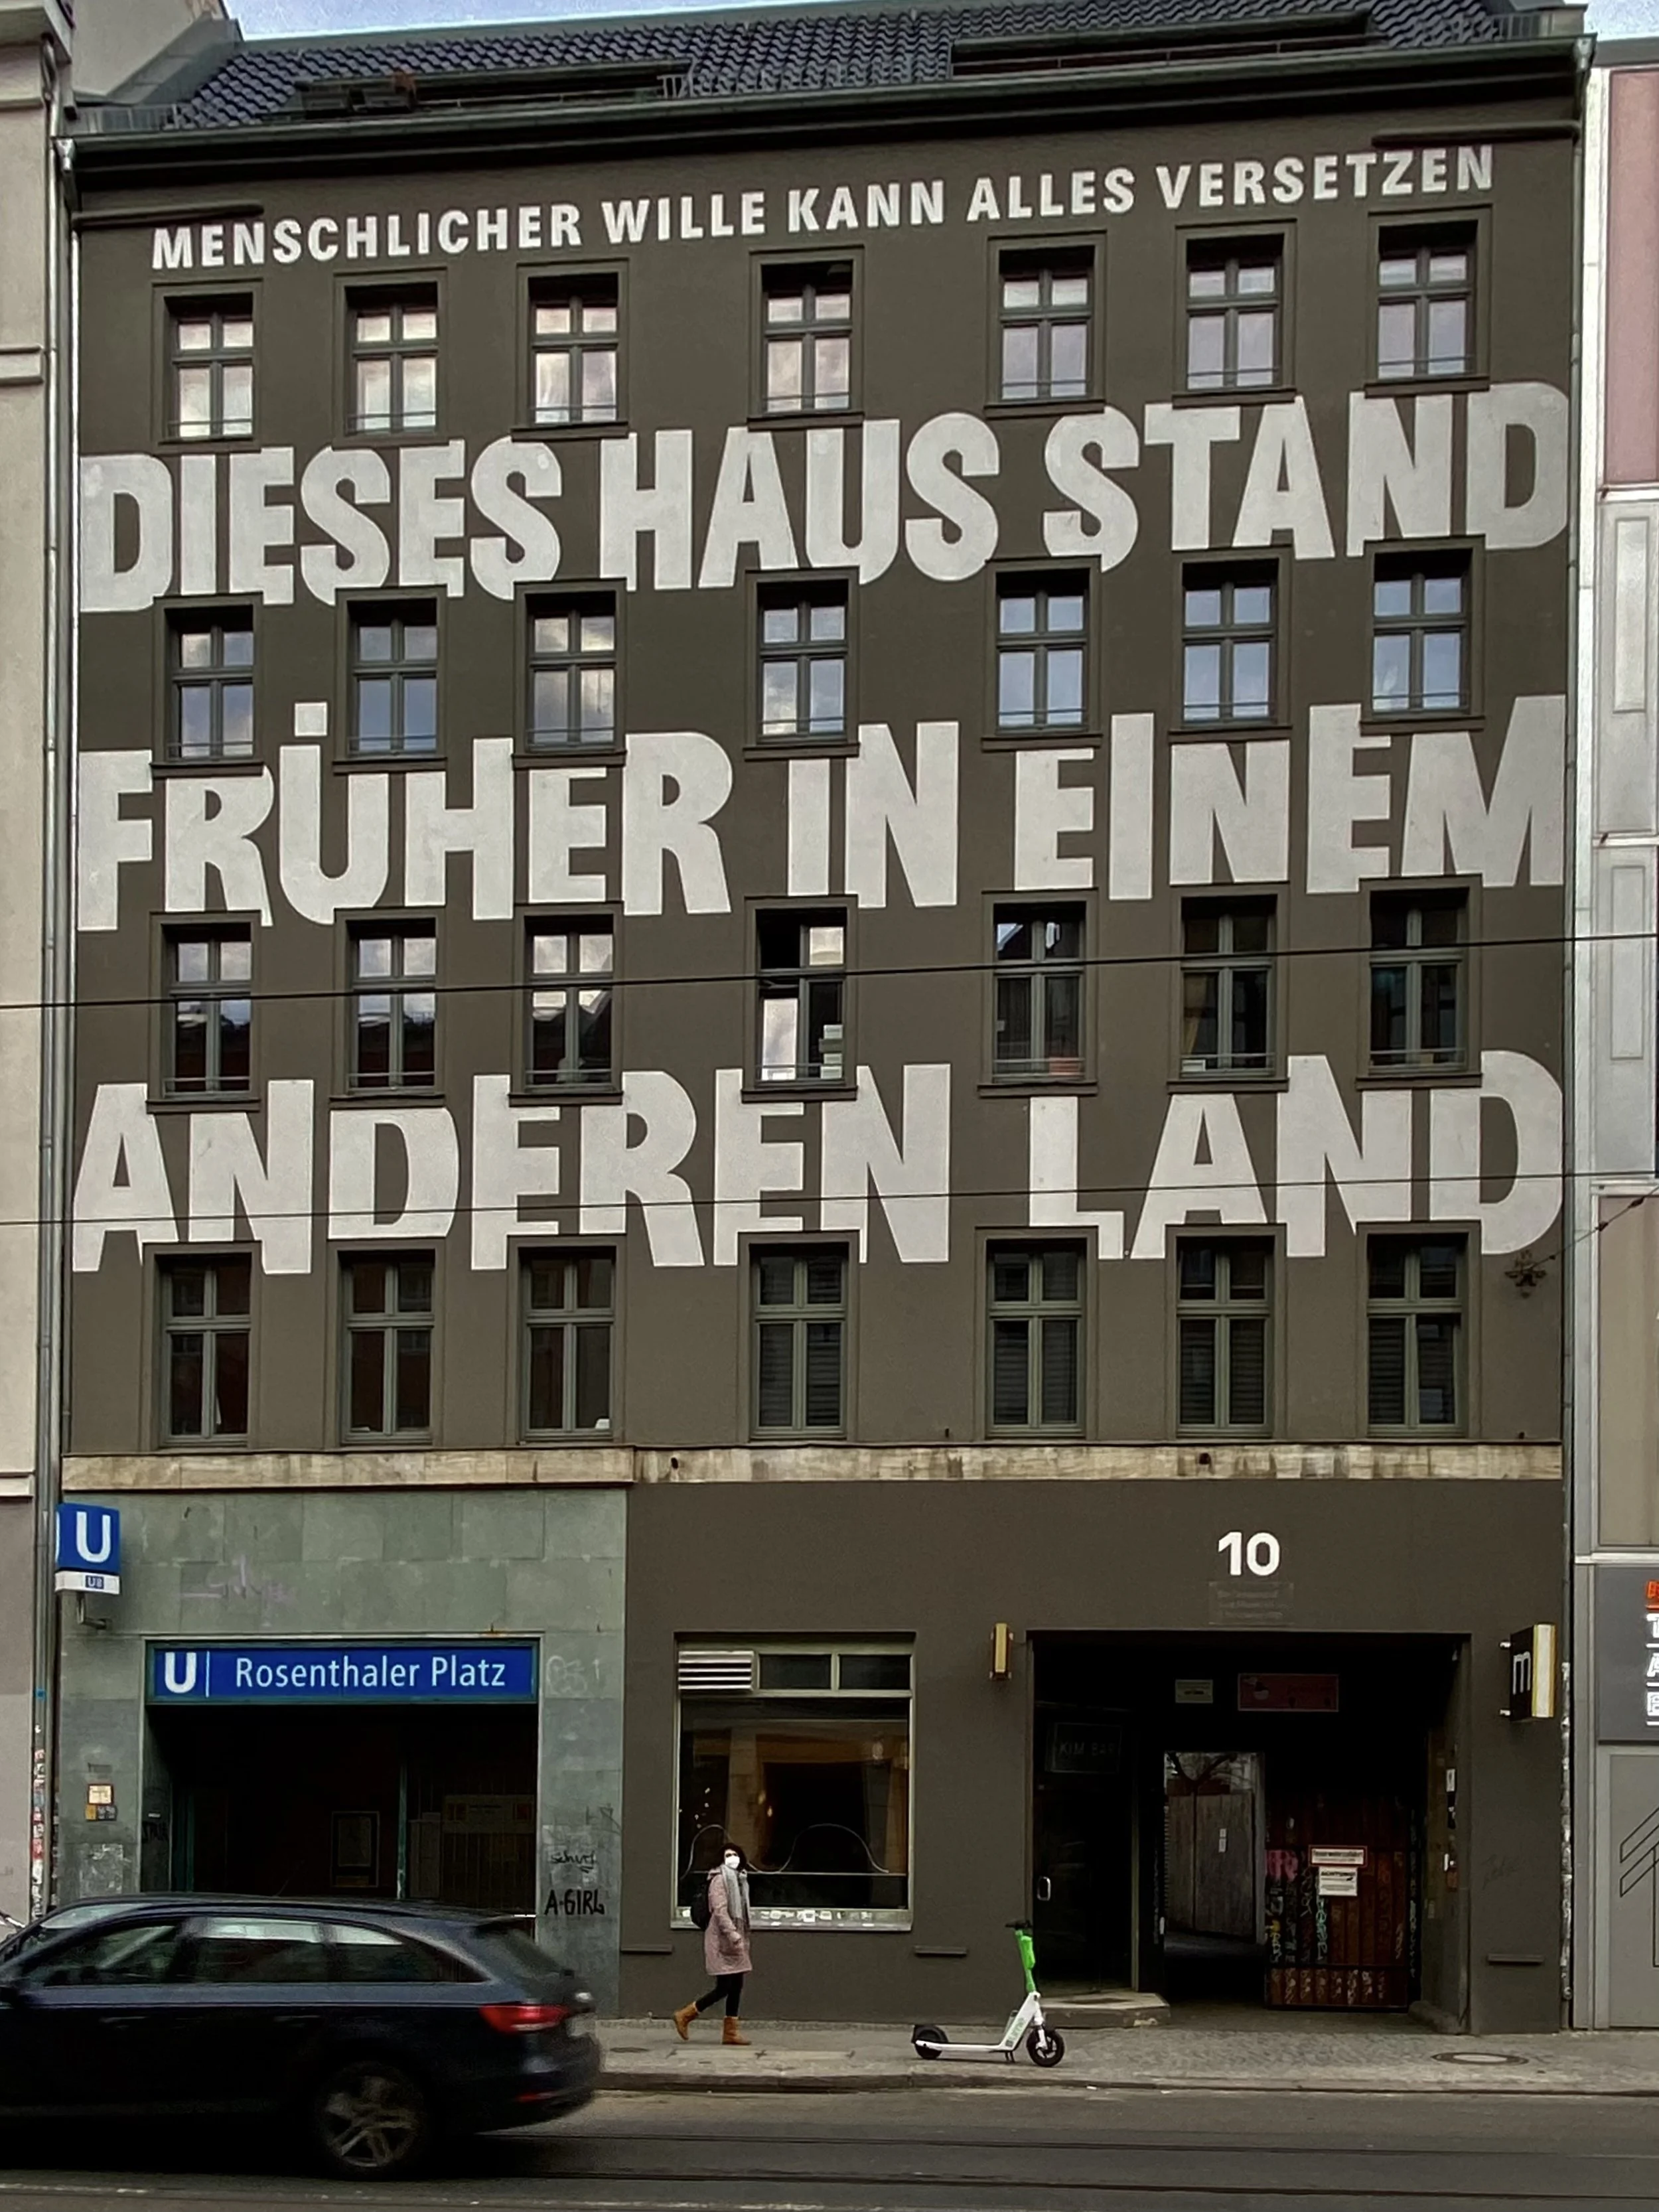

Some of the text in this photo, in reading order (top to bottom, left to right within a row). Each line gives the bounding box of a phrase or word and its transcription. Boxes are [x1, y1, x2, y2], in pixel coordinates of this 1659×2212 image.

[151, 145, 1492, 270] MENSCHLICHER WILLE KANN ALLES VERSETZEN
[79, 382, 1569, 613] DIESES HAUS STAND
[787, 721, 959, 909] IN
[1013, 694, 1566, 901] EINEM
[72, 1050, 1563, 1275] ANDEREN LAND
[76, 1511, 111, 1563] U
[1218, 1531, 1280, 1576] 10
[165, 1652, 196, 1694] U
[236, 1655, 420, 1688] Rosenthaler
[431, 1655, 506, 1687] Platz
